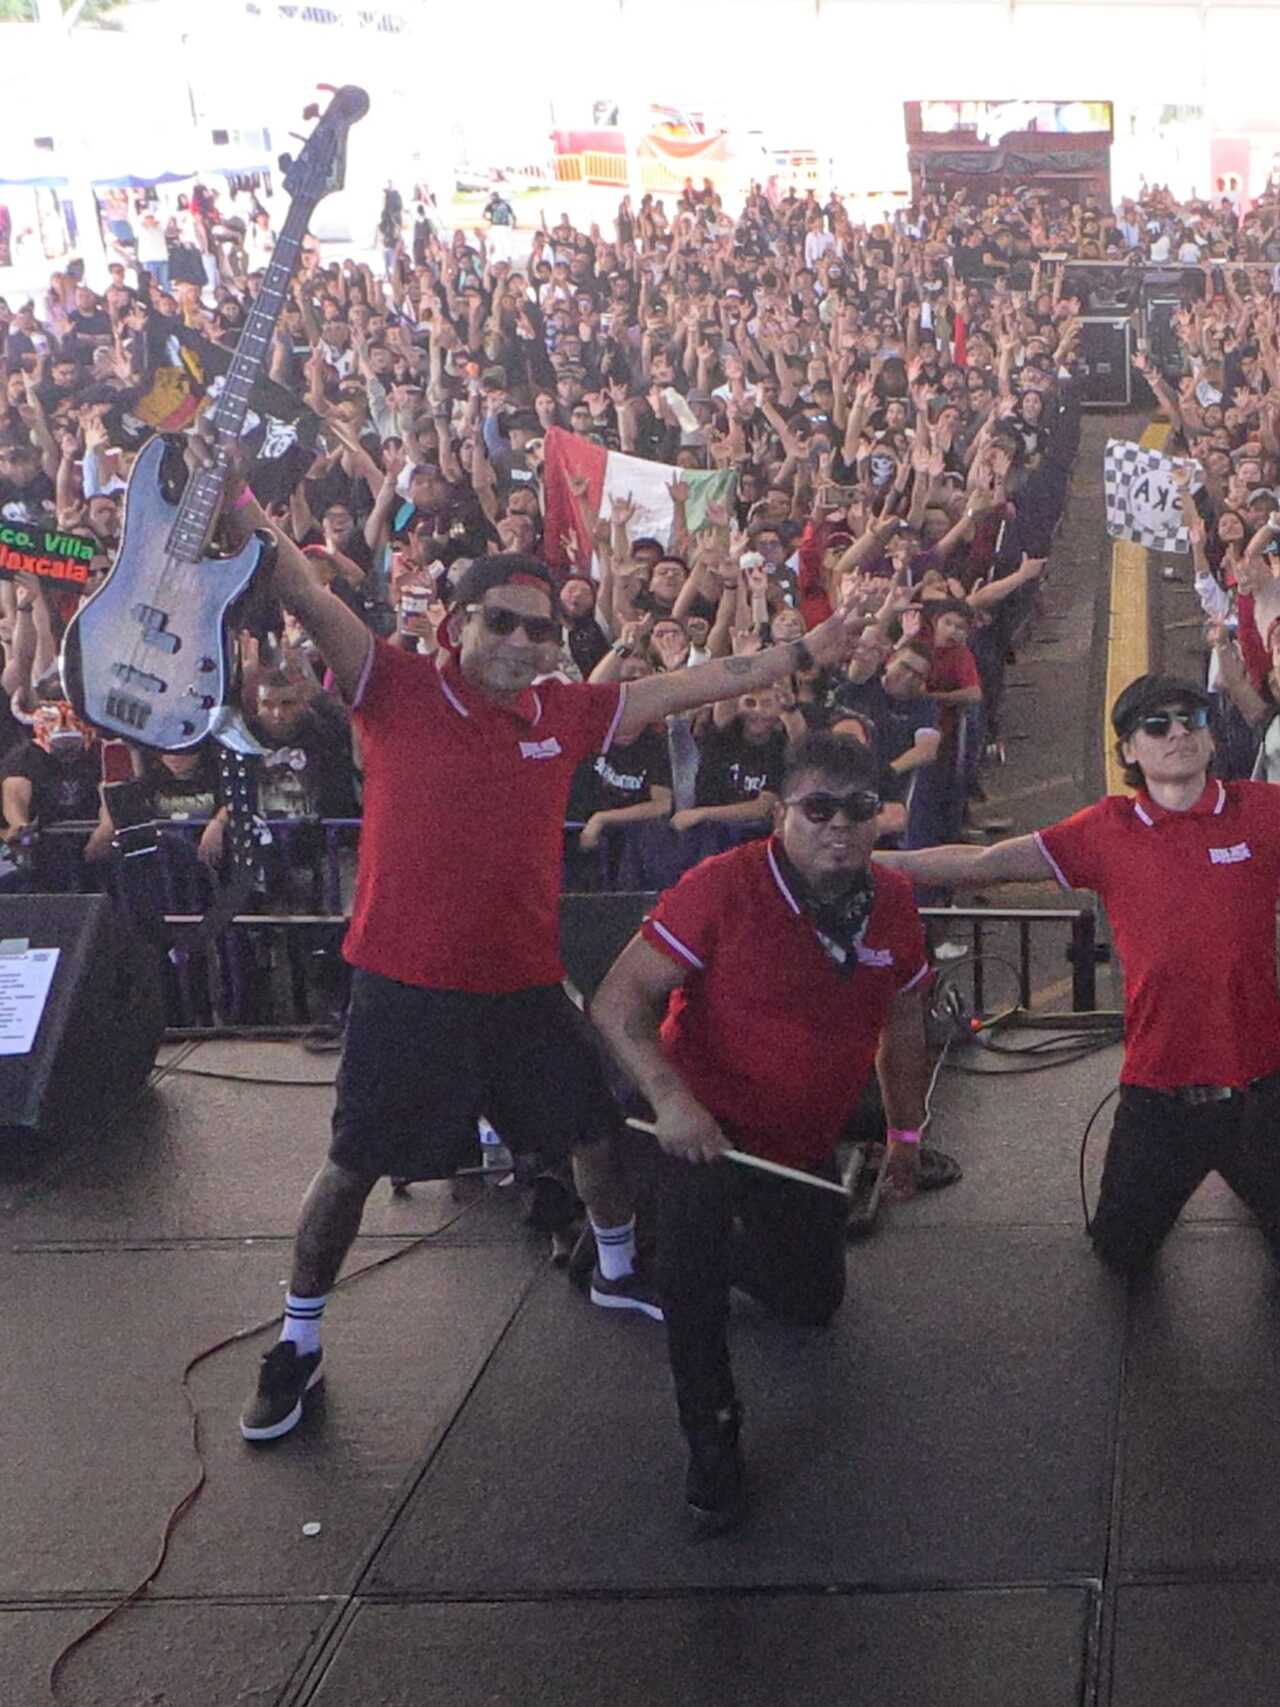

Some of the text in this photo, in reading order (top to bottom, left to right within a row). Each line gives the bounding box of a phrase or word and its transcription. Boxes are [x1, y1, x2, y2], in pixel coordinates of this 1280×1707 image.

[0, 525, 94, 560] co. Villa
[0, 544, 88, 583] laxcala
